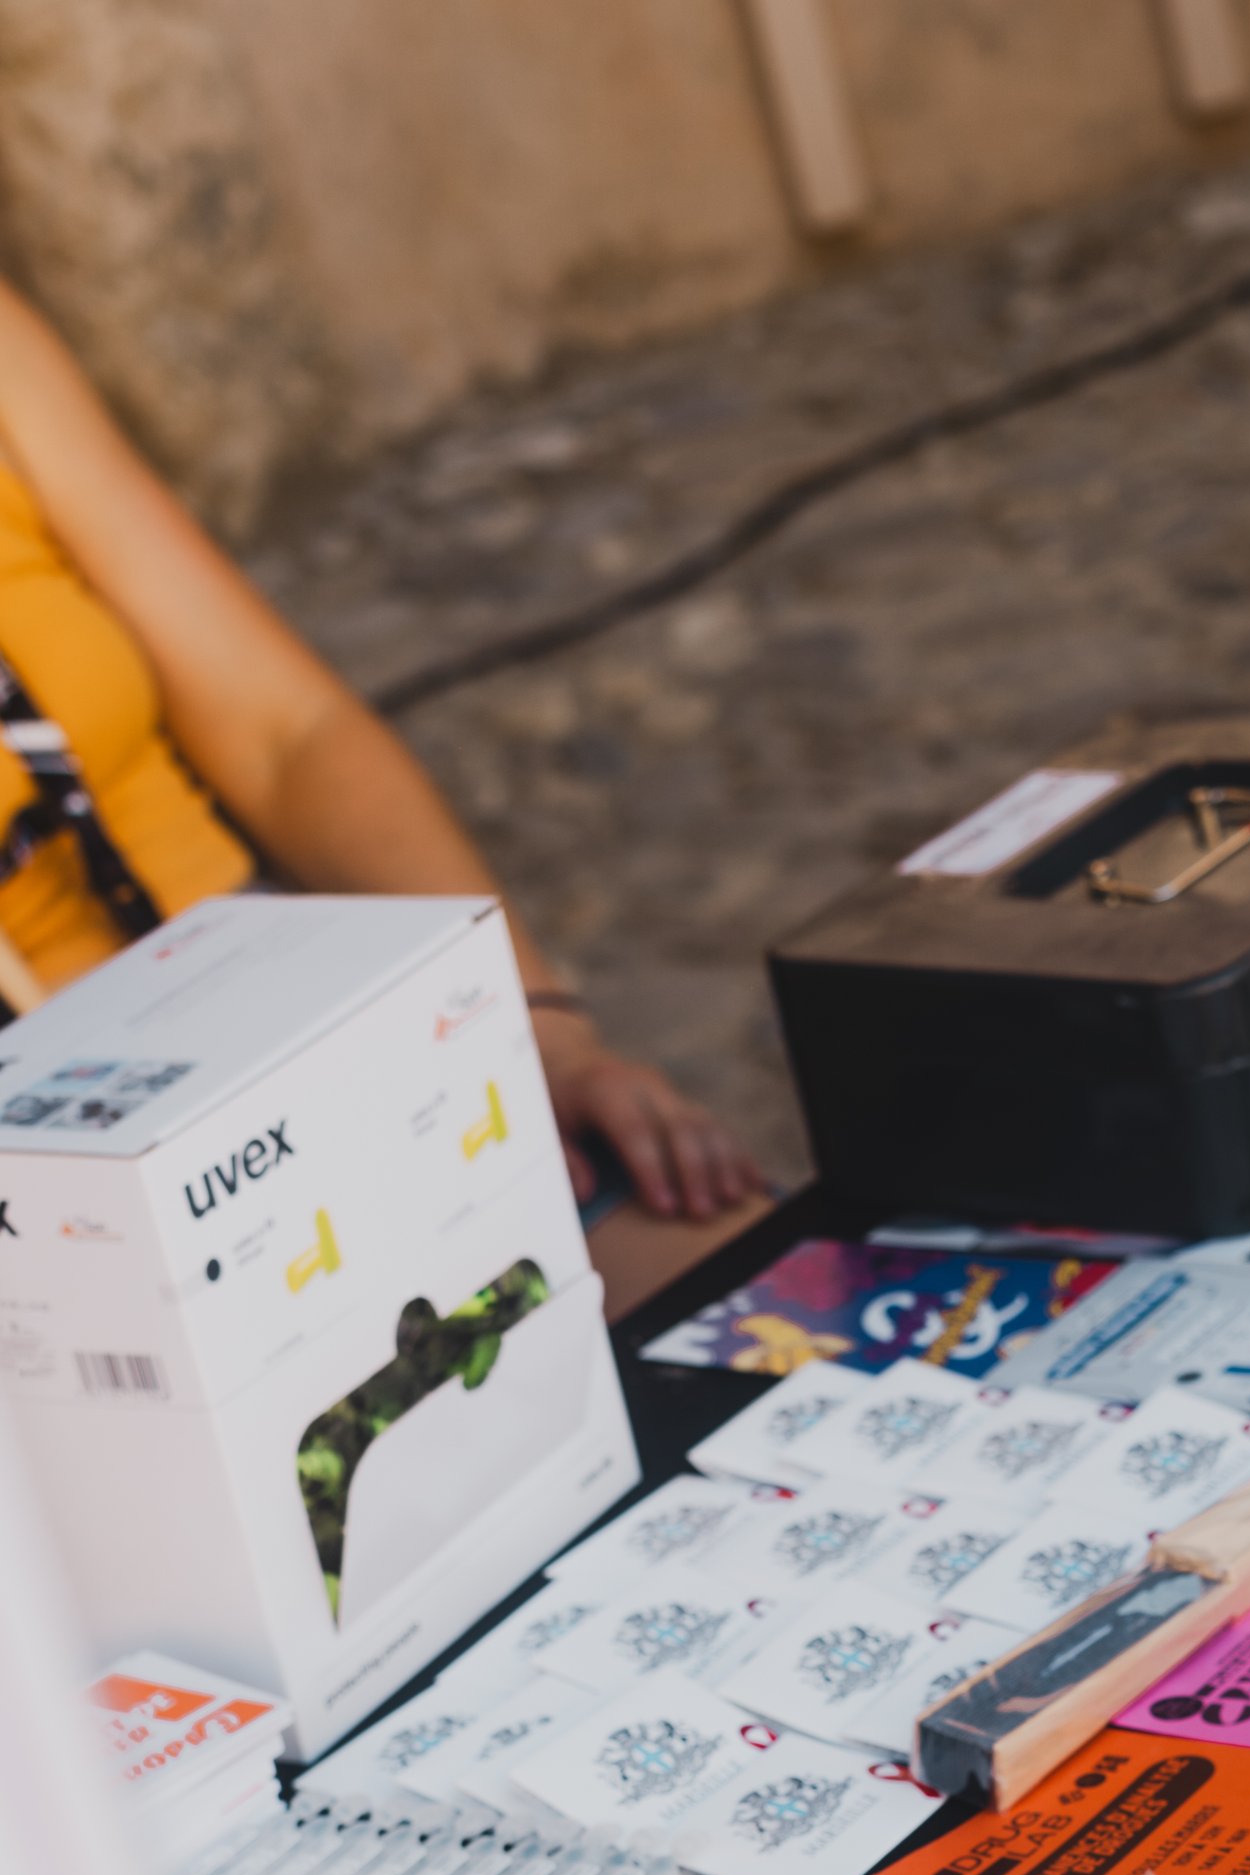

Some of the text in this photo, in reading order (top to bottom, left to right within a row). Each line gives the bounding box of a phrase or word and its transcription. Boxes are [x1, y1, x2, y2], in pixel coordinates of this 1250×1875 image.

[185, 1120, 294, 1218] uvex
[951, 1810, 1042, 1874] DRUG
[1005, 1814, 1073, 1862] LAB
